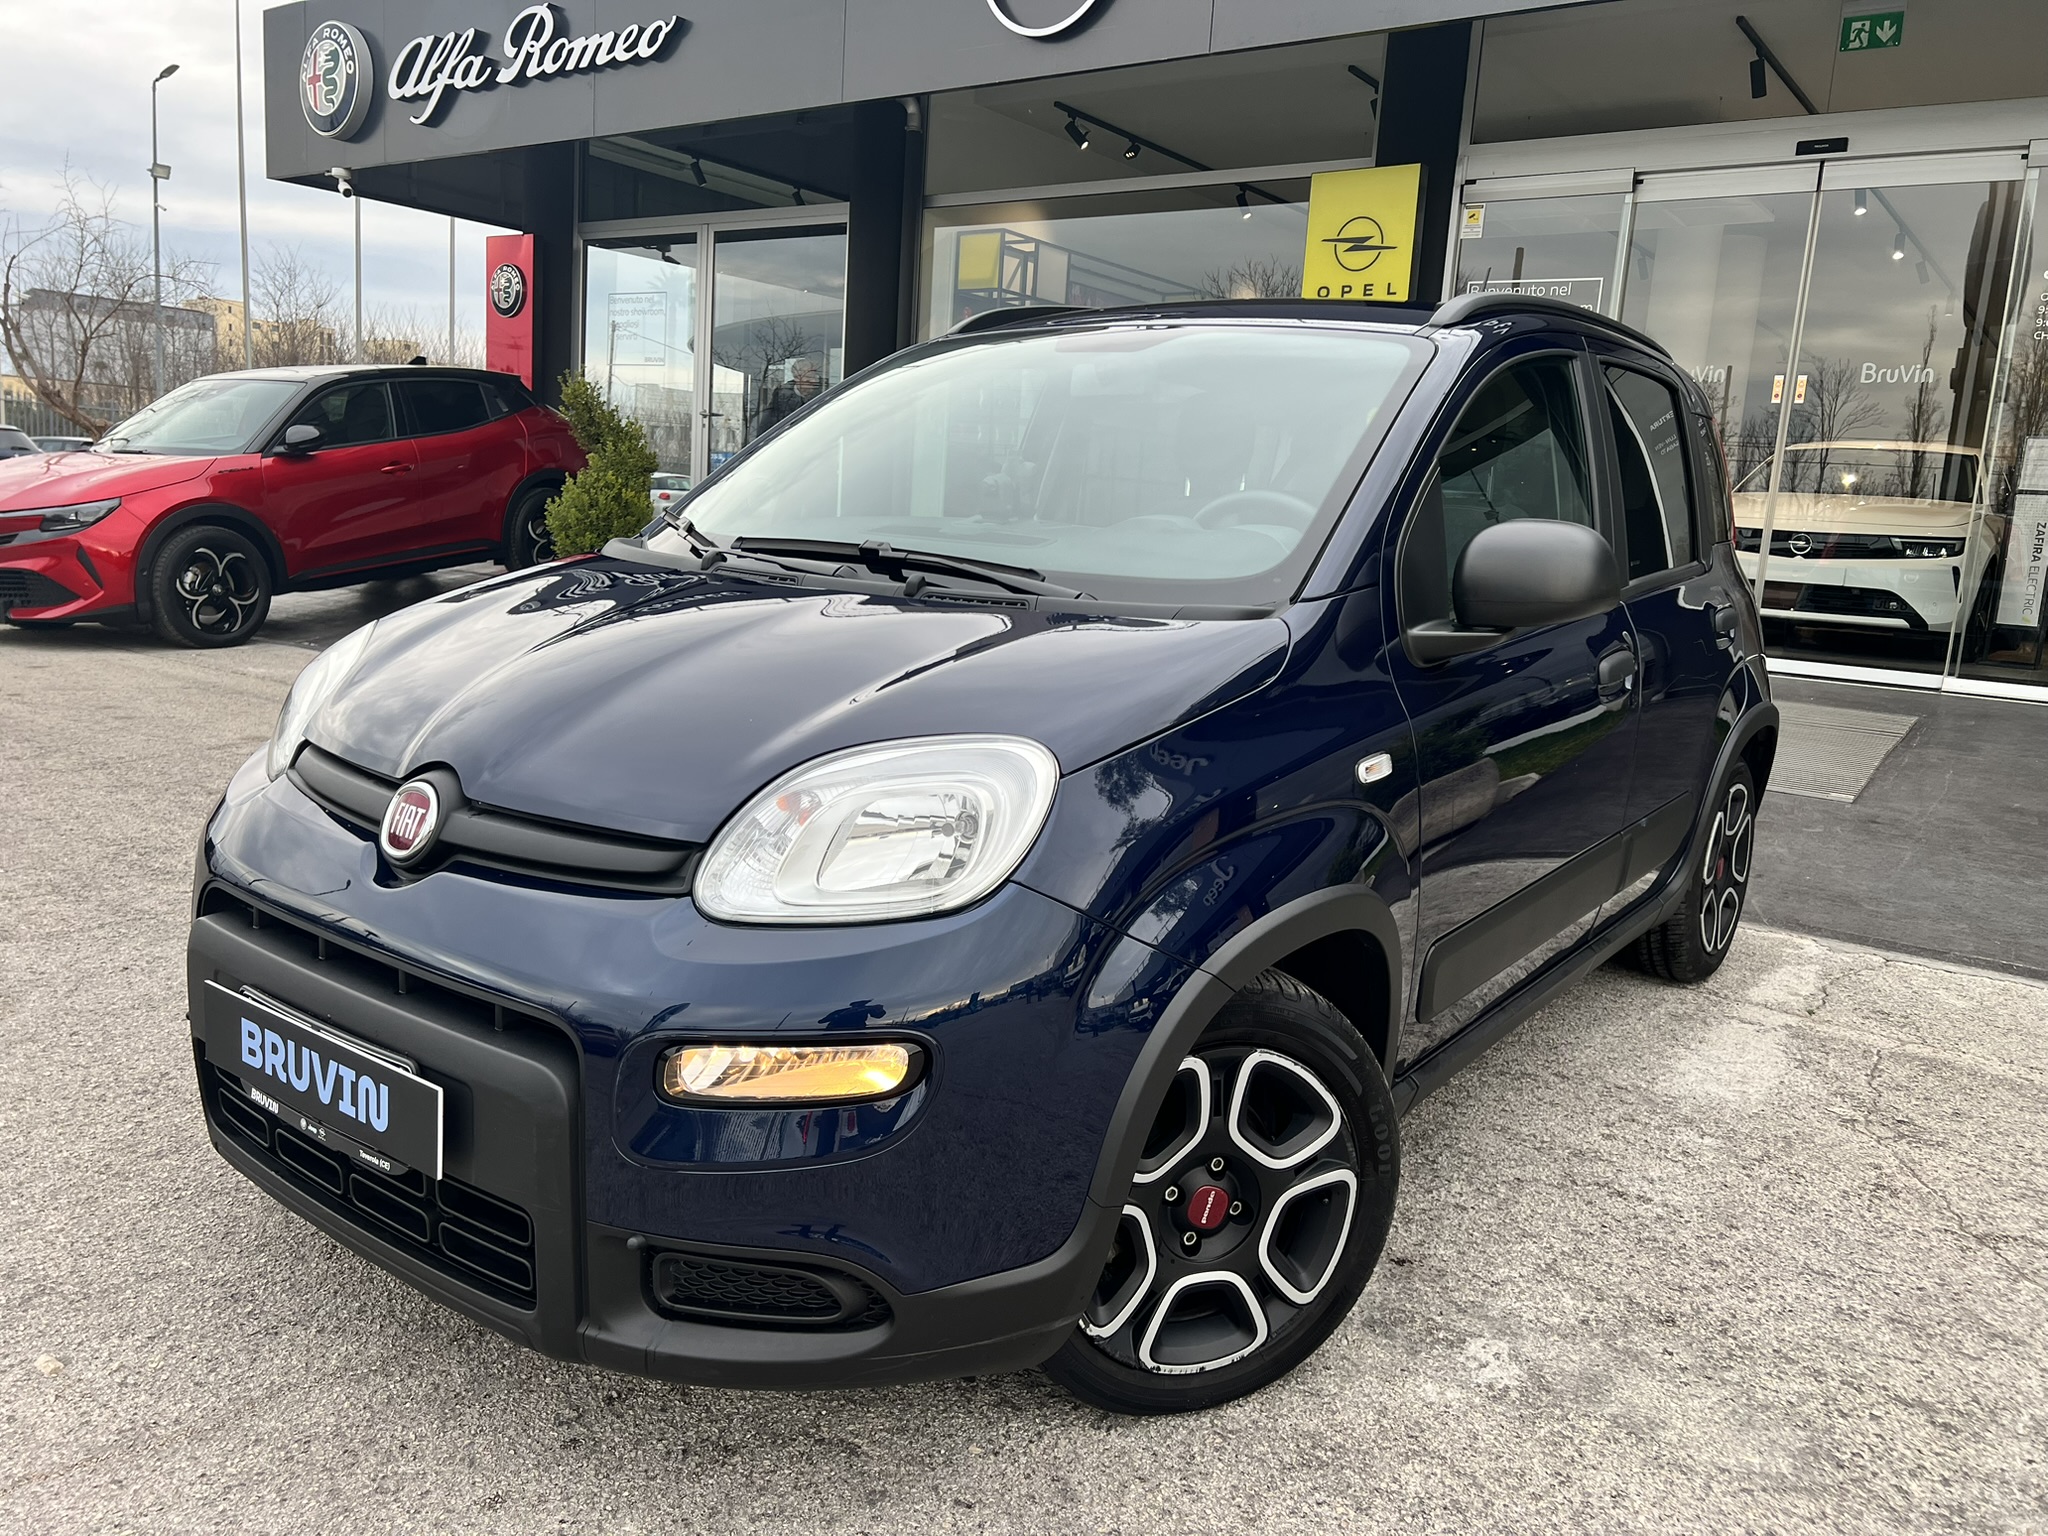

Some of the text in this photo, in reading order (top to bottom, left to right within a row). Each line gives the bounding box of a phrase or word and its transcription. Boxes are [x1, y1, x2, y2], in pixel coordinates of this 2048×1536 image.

[302, 28, 355, 82] ALFA ROMEO
[387, 3, 677, 125] Alfa Romeo
[503, 266, 520, 291] ROMEO
[1317, 283, 1397, 298] OPEL
[1550, 282, 1571, 296] nel
[1860, 362, 1935, 383] BruVin
[2031, 522, 2047, 562] ZAFIRA
[2022, 566, 2040, 615] ELECTRIC
[390, 801, 427, 840] FIAT
[240, 1016, 389, 1133] BRUVIN
[251, 1087, 279, 1114] BRUVIN
